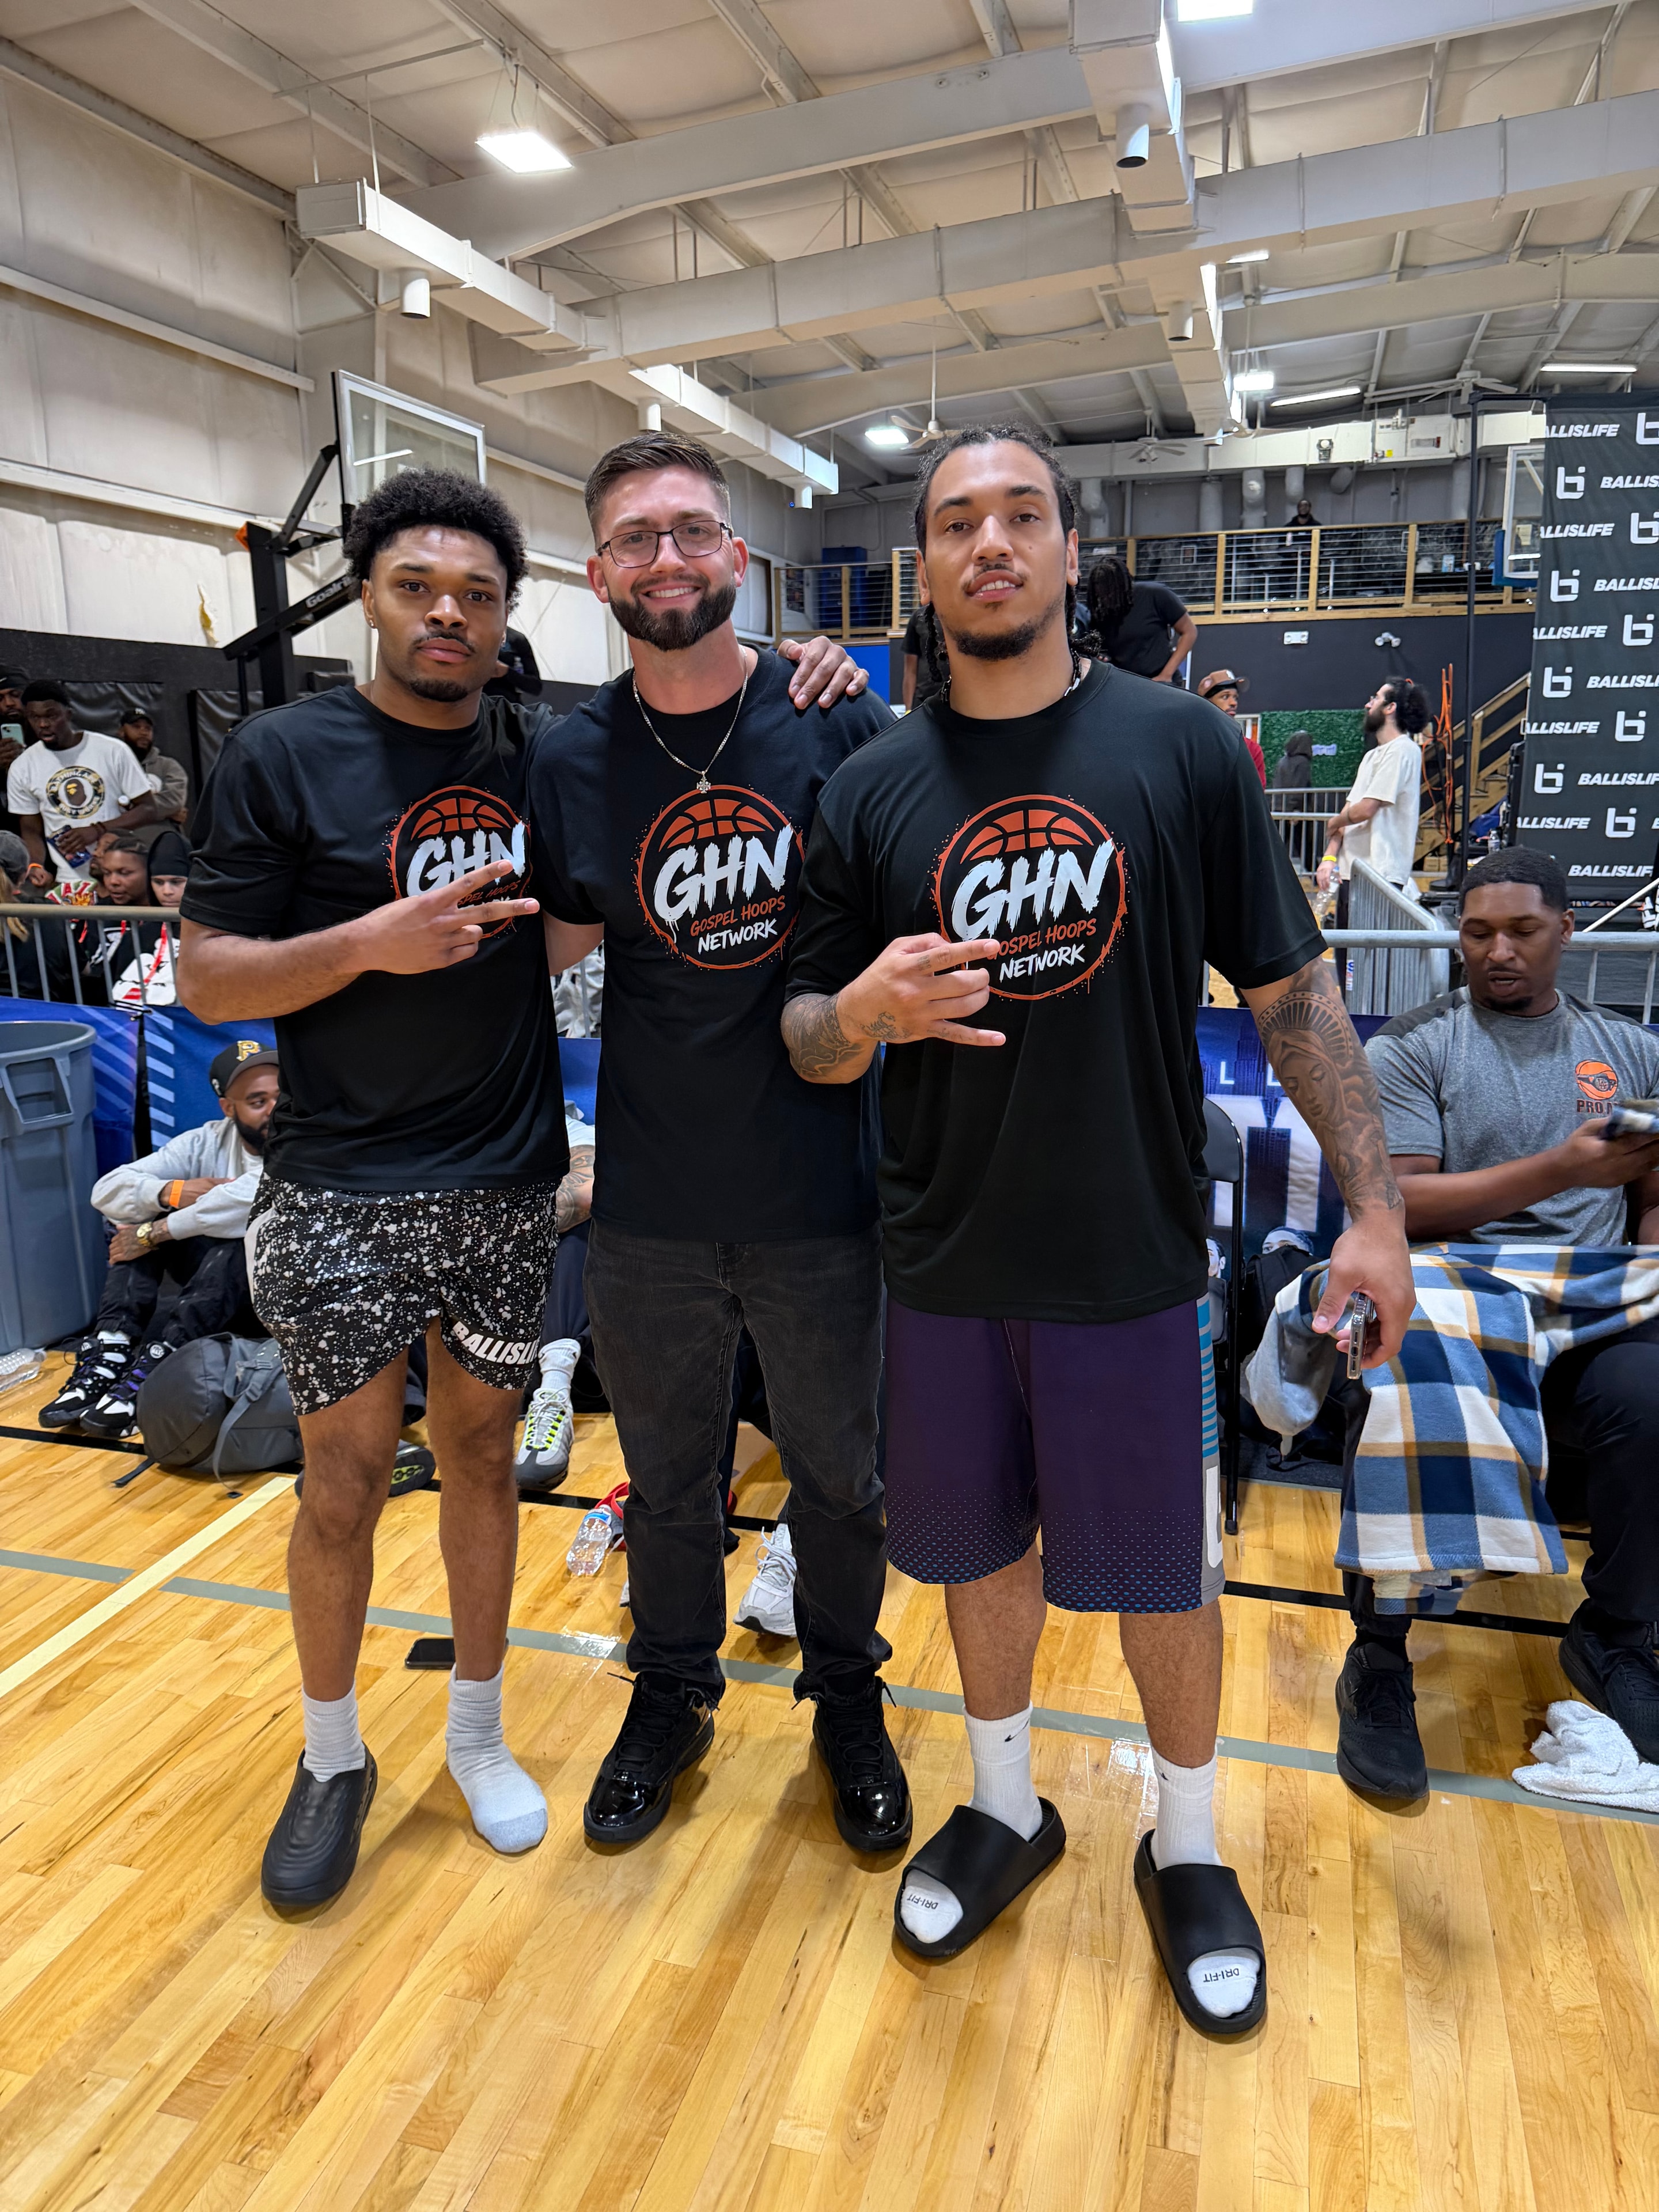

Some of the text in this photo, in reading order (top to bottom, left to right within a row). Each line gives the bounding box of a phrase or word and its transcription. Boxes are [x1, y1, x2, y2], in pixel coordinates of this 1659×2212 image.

[406, 820, 526, 897] GHN
[653, 823, 794, 922] GHN
[950, 838, 1115, 942] GHN
[691, 895, 786, 937] GOSPEL HOOPS
[1045, 918, 1097, 944] HOOPS
[698, 918, 778, 955] NETWORK
[999, 943, 1086, 983] NETWORK
[236, 1040, 260, 1062] P
[1576, 1099, 1604, 1114] PRO
[906, 1893, 939, 1910] DRI-FIT
[1203, 1968, 1240, 1983] DRI-FIT
